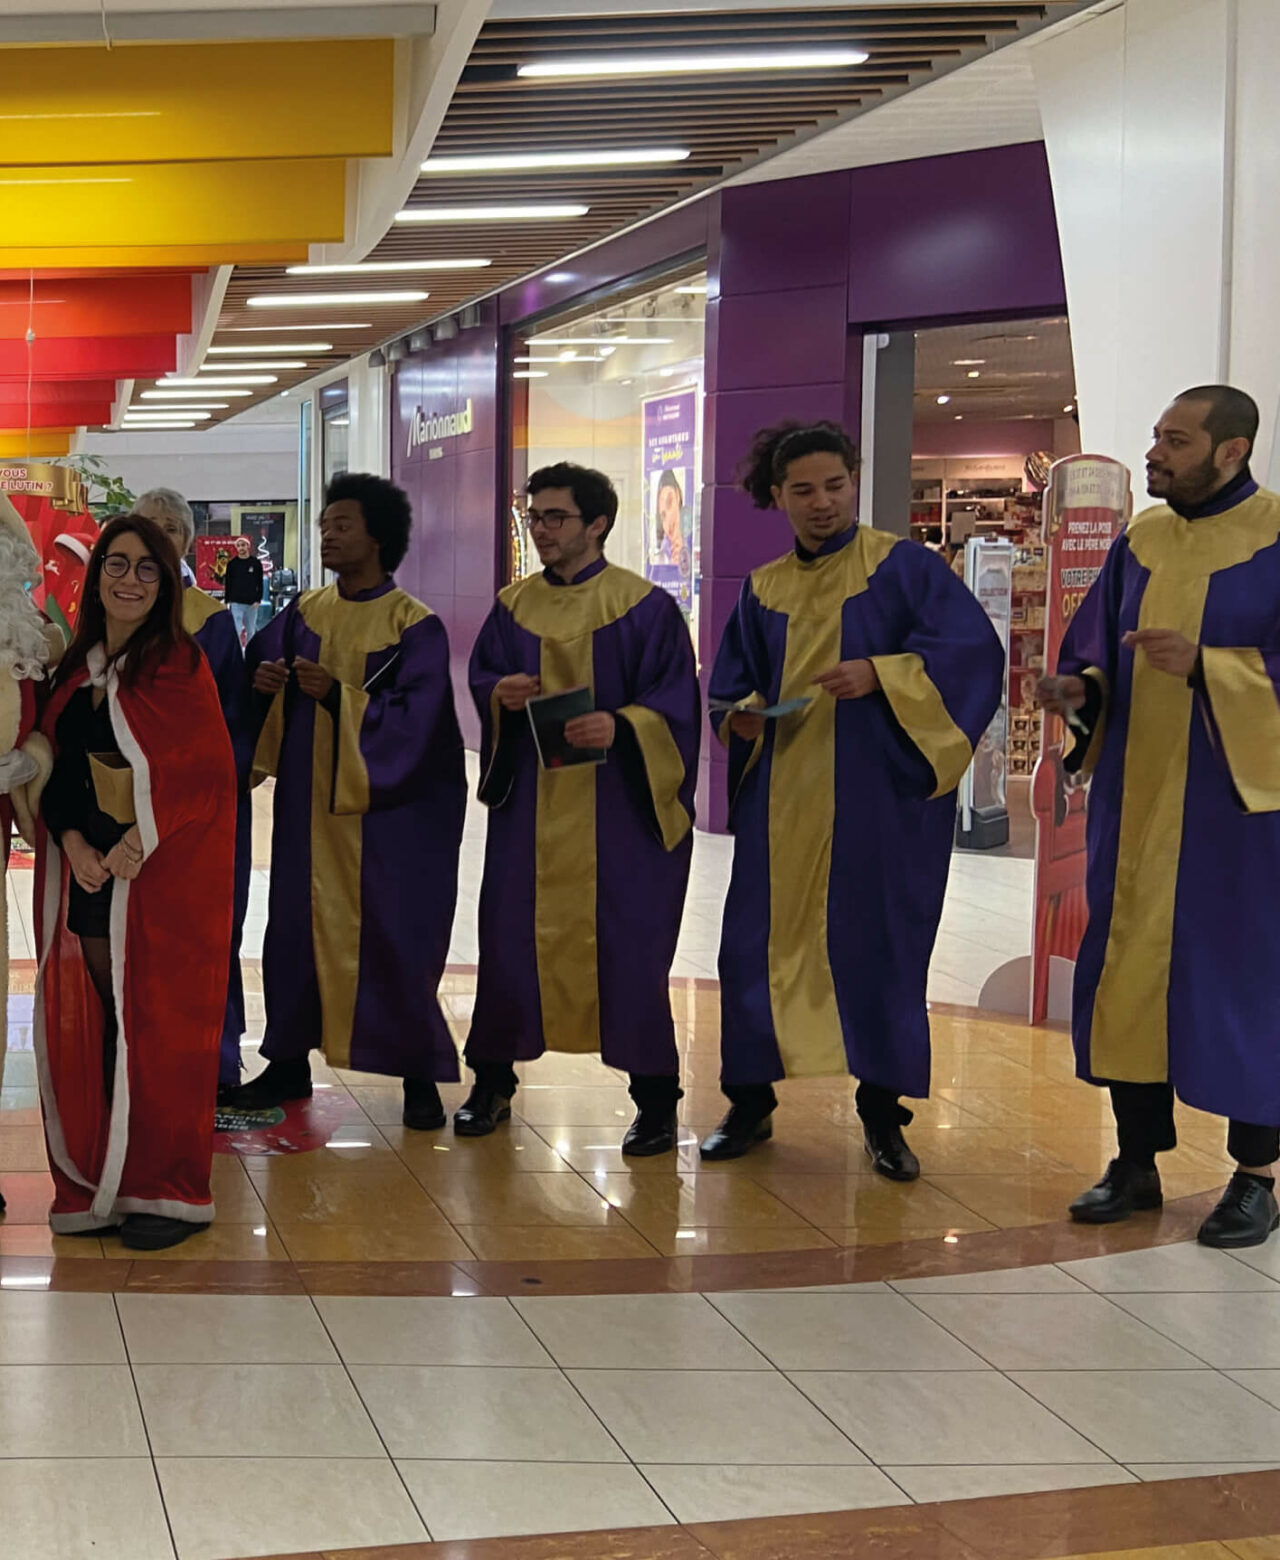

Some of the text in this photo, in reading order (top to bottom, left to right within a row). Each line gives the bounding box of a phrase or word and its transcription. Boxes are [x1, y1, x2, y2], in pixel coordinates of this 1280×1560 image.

[407, 398, 471, 457] Marionnaud
[10, 481, 44, 491] LUTIN
[1061, 567, 1087, 589] VOTRE
